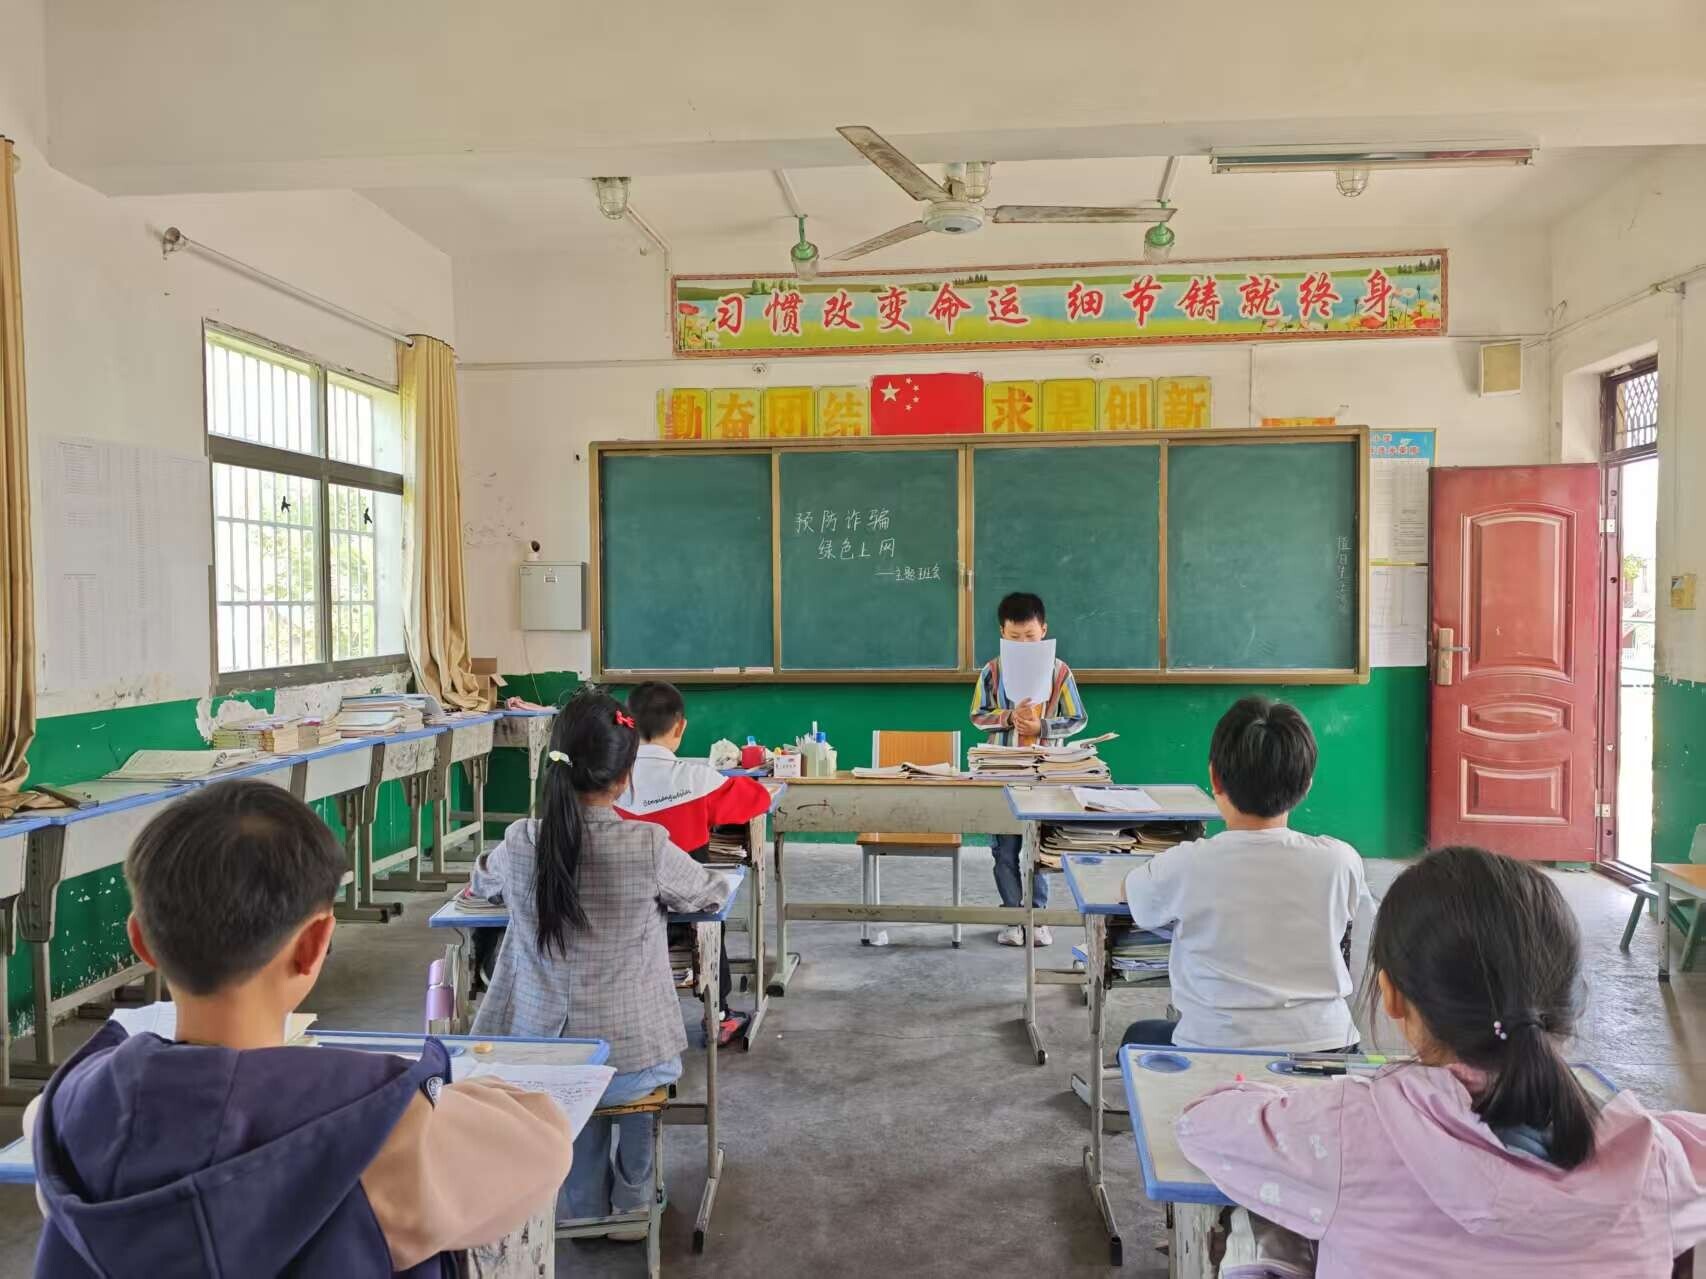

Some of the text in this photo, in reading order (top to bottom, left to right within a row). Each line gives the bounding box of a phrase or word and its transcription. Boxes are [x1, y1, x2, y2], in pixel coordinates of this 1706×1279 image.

[716, 268, 1393, 335] 习惯改变命运 细节铸就终身
[991, 382, 1207, 432] 求是创新
[794, 508, 890, 533] 预防诈骗
[818, 537, 896, 560] 绿色上网
